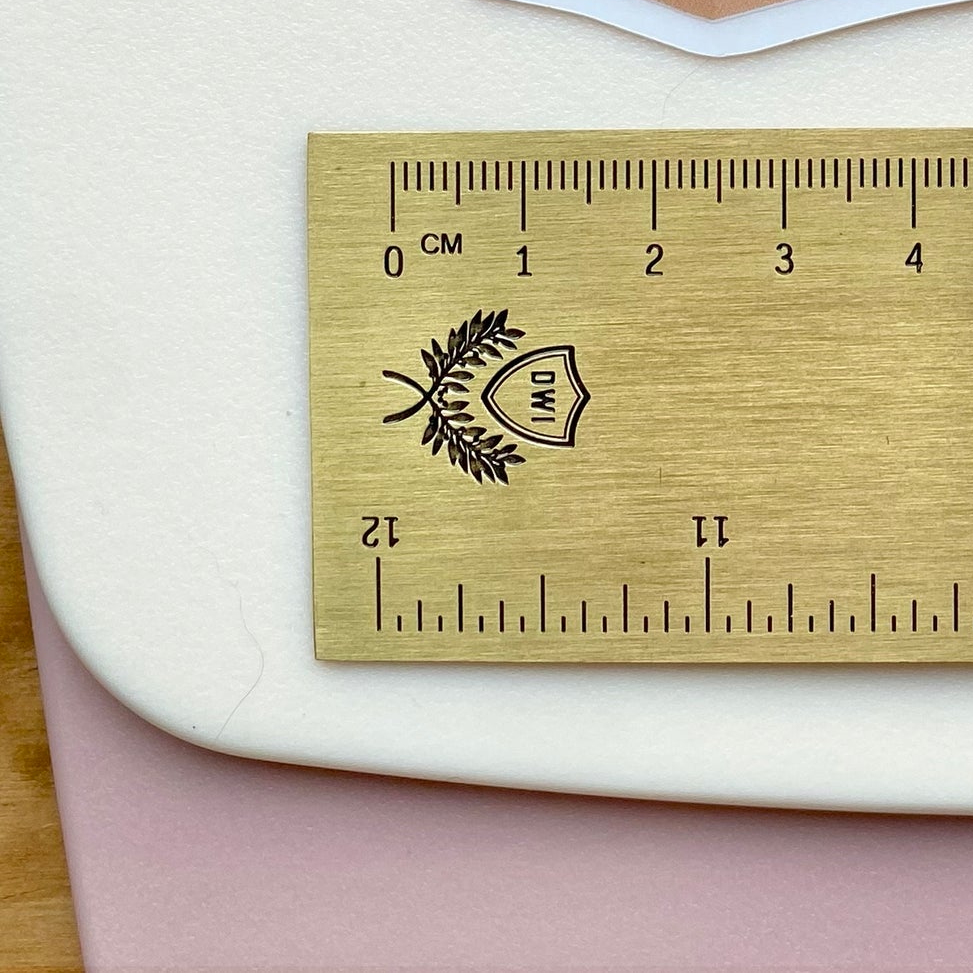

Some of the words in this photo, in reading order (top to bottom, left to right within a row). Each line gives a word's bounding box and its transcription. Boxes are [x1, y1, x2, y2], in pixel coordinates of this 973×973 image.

[384, 245, 404, 278] 0
[516, 245, 533, 277] 1
[645, 243, 664, 276] 2
[774, 242, 795, 275] 3
[904, 242, 924, 274] 4
[420, 233, 463, 255] CM
[530, 370, 556, 423] DWI
[361, 516, 400, 548] 12
[691, 515, 730, 548] 11
